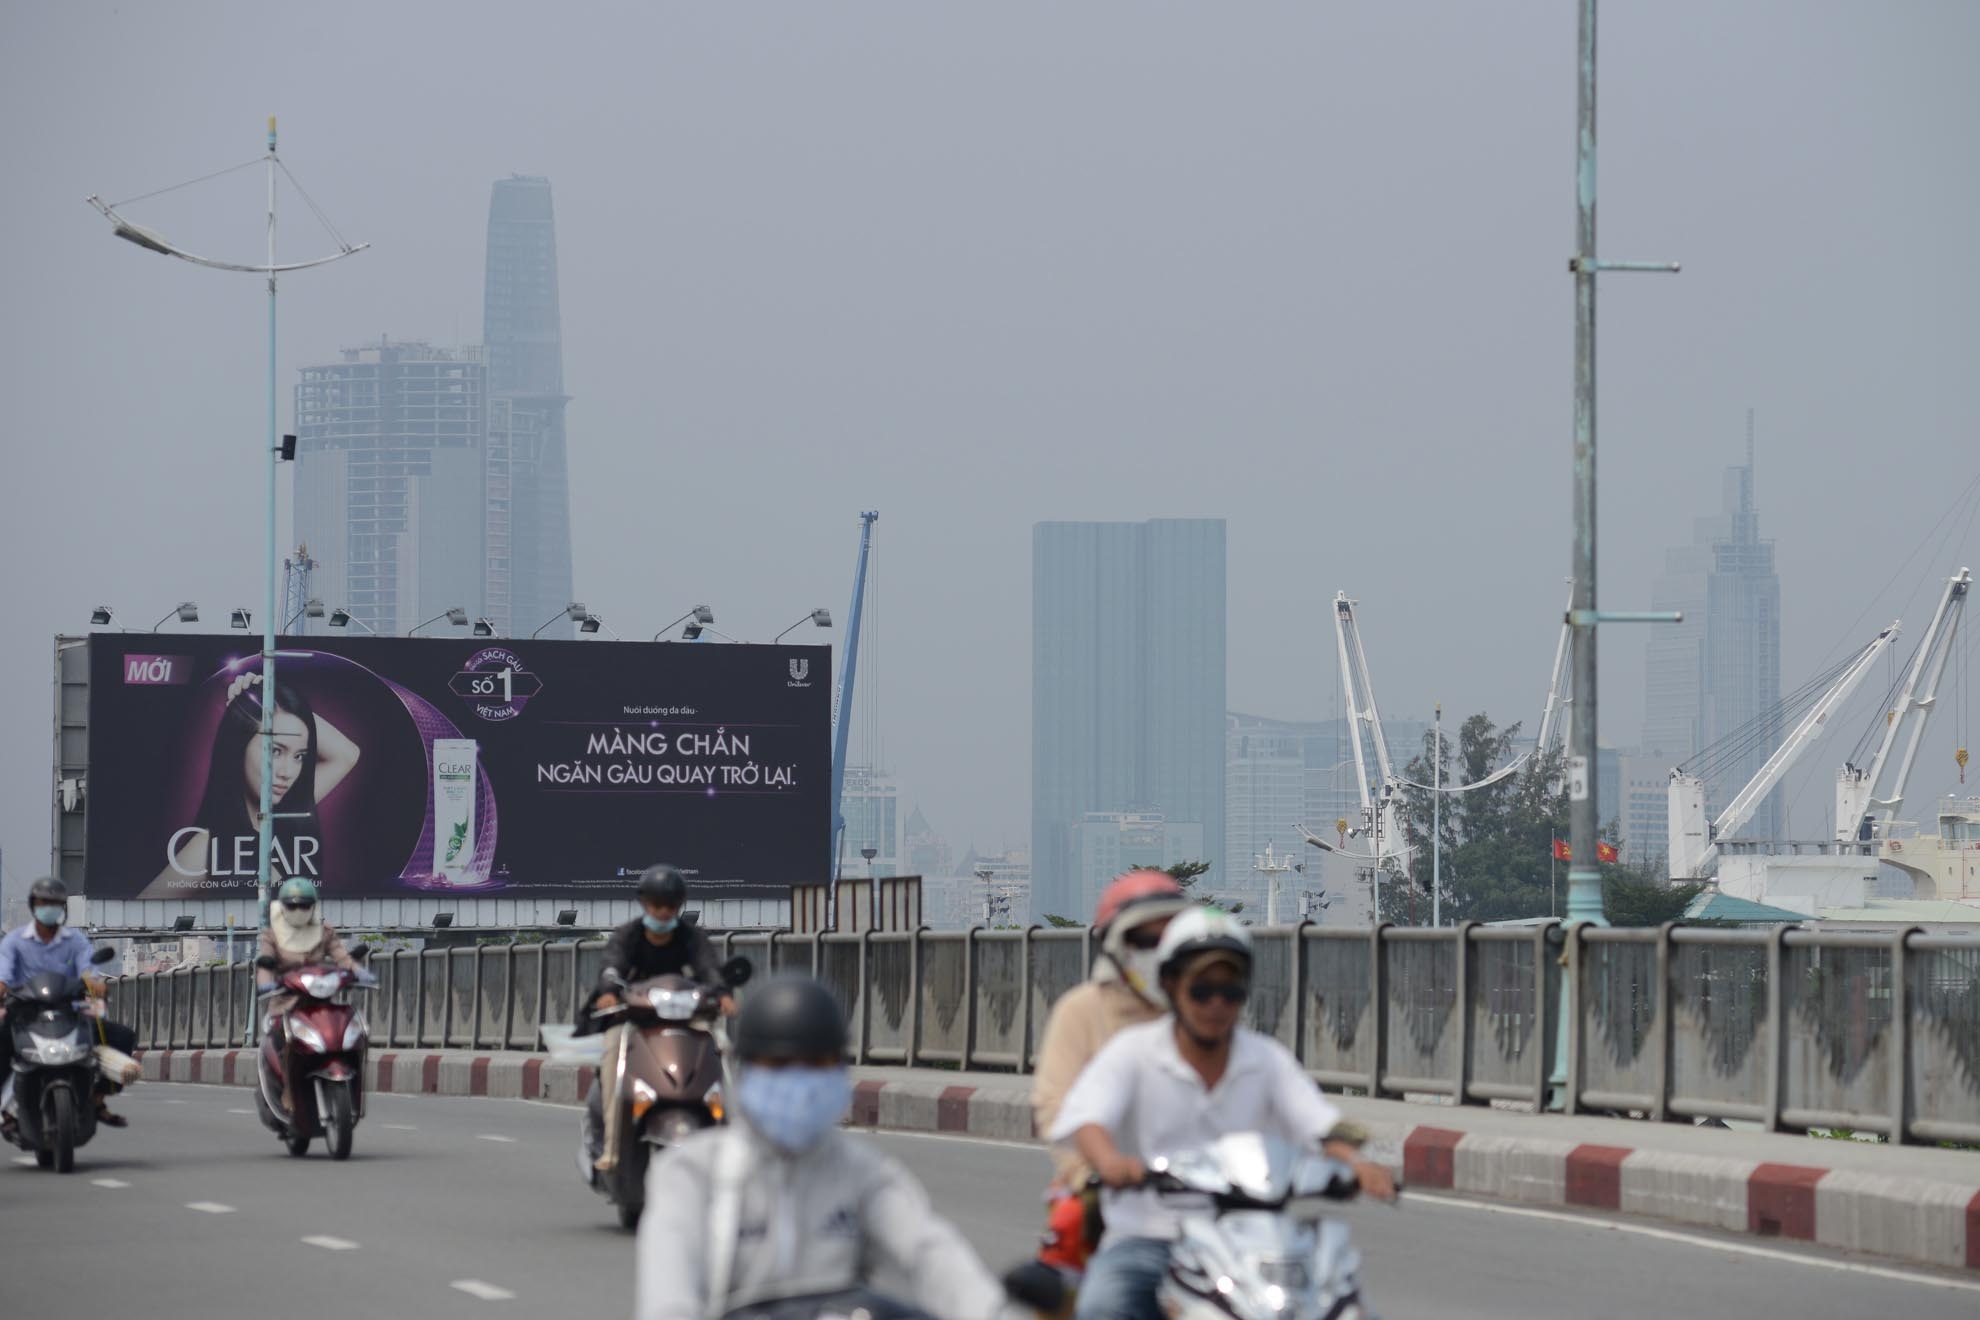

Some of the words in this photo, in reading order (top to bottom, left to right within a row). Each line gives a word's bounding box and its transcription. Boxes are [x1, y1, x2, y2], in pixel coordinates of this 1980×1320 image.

[127, 656, 173, 682] MỚI
[471, 675, 494, 694] SỐ
[497, 667, 512, 702] 1
[494, 706, 515, 718] NAM
[587, 727, 668, 755] MÀNG
[676, 726, 750, 756] CHẮN
[438, 761, 472, 774] CLEAR
[537, 760, 601, 784] NGĂN
[607, 760, 652, 784] GÀU
[657, 764, 716, 784] QUAY
[720, 760, 759, 785] TRỞ
[166, 826, 319, 877] CLEAR
[167, 879, 199, 889] KHÔNG
[200, 879, 219, 889] CÒN
